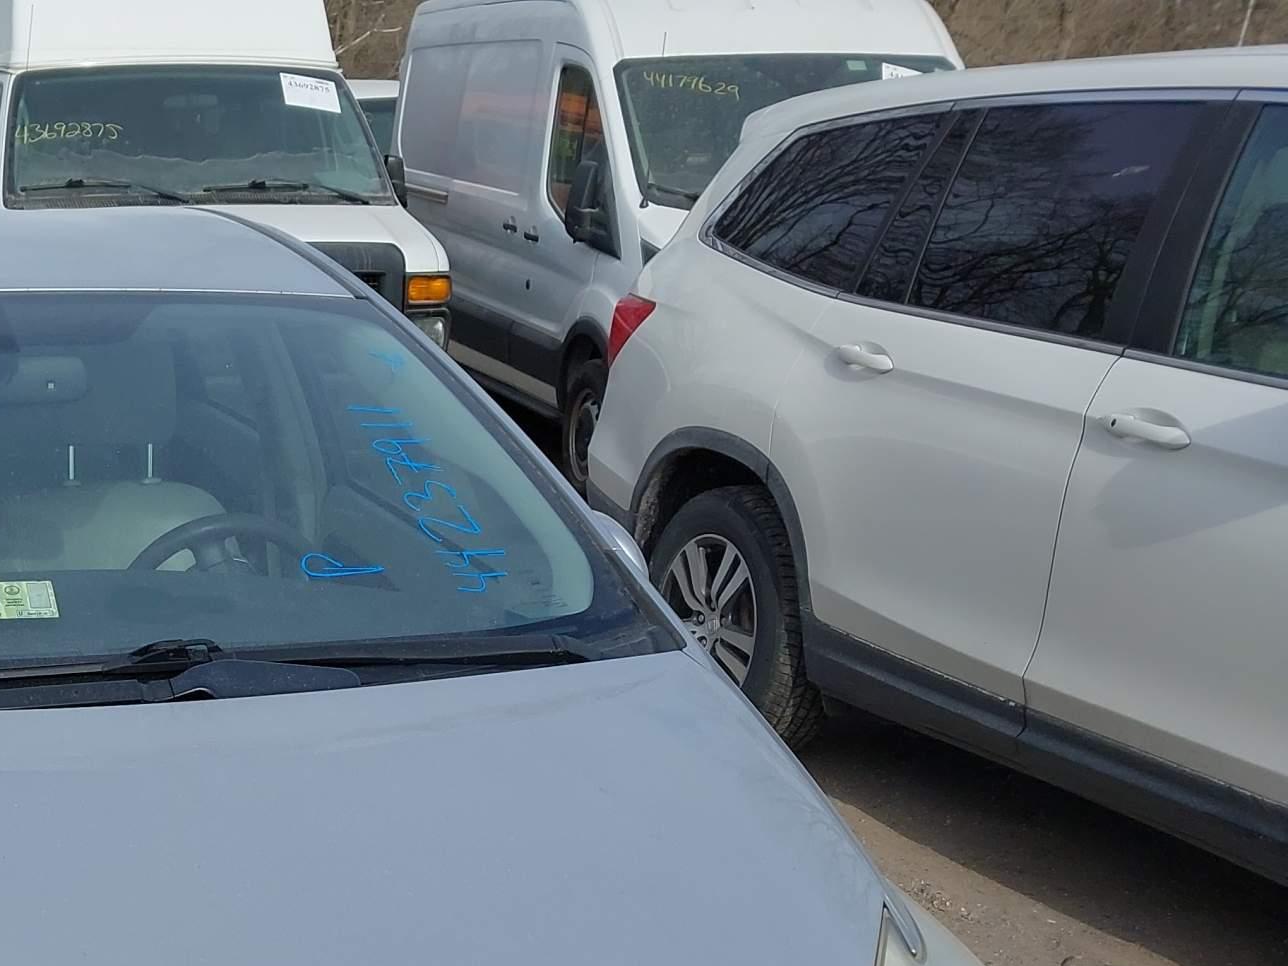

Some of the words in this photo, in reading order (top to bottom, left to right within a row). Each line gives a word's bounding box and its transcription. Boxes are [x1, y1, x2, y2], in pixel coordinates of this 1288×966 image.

[644, 71, 740, 101] 44179629
[15, 122, 123, 144] 43692875
[346, 404, 509, 593] 44237911
